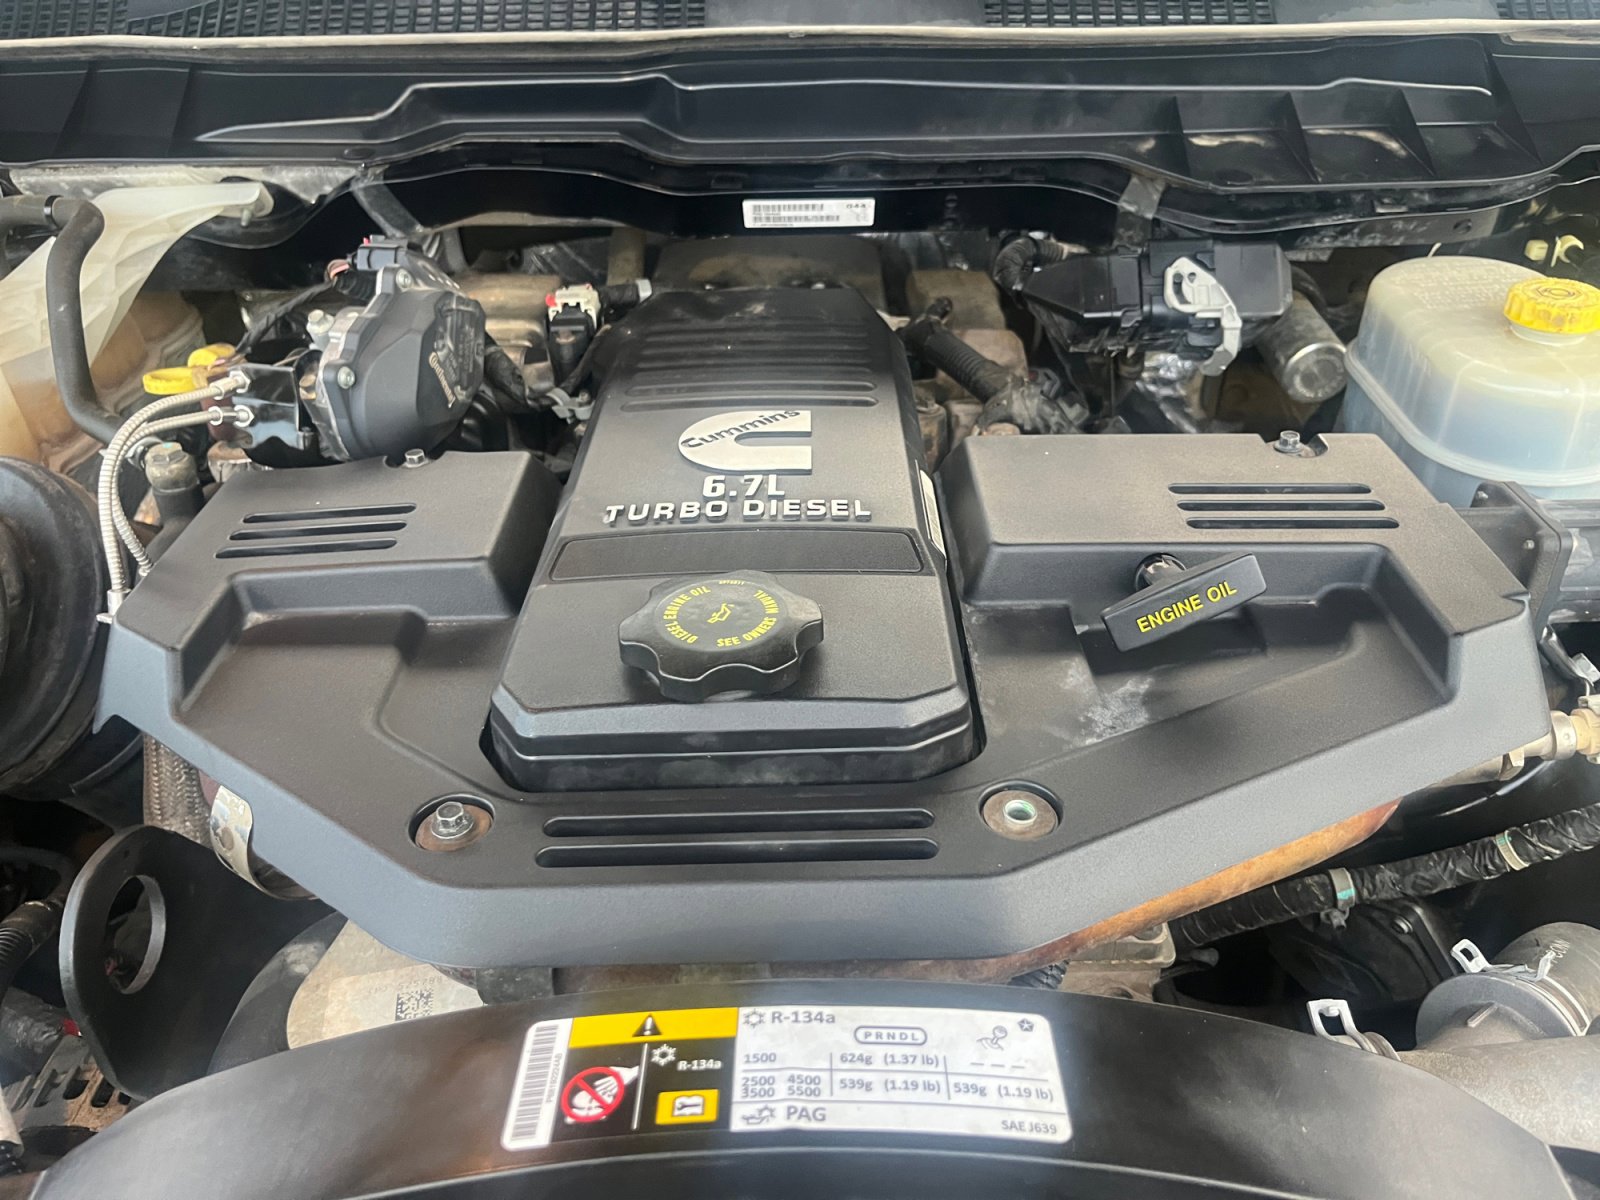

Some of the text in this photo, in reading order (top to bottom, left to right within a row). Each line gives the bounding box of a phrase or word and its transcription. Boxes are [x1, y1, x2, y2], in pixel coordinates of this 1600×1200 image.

[680, 409, 801, 448] Cummins
[702, 474, 786, 499] 6.7L
[603, 499, 872, 527] TURBO DIESEL
[665, 621, 699, 644] DIESEL
[689, 585, 712, 597] OIL
[1136, 581, 1238, 633] ENGINE OIL
[716, 636, 742, 647] SEE
[771, 1010, 837, 1025] R-134a
[676, 1059, 723, 1071] R-134a
[743, 1052, 940, 1068] 1500 624g (1.37 lb)
[741, 1074, 822, 1087] 2500 4500
[839, 1078, 941, 1094] 539g (1.19 lb)
[741, 1085, 822, 1099] 3500 5500
[953, 1082, 1054, 1103] 539g (1.19 lb)
[786, 1105, 828, 1122] PAG
[1001, 1119, 1058, 1135] SAE J639
